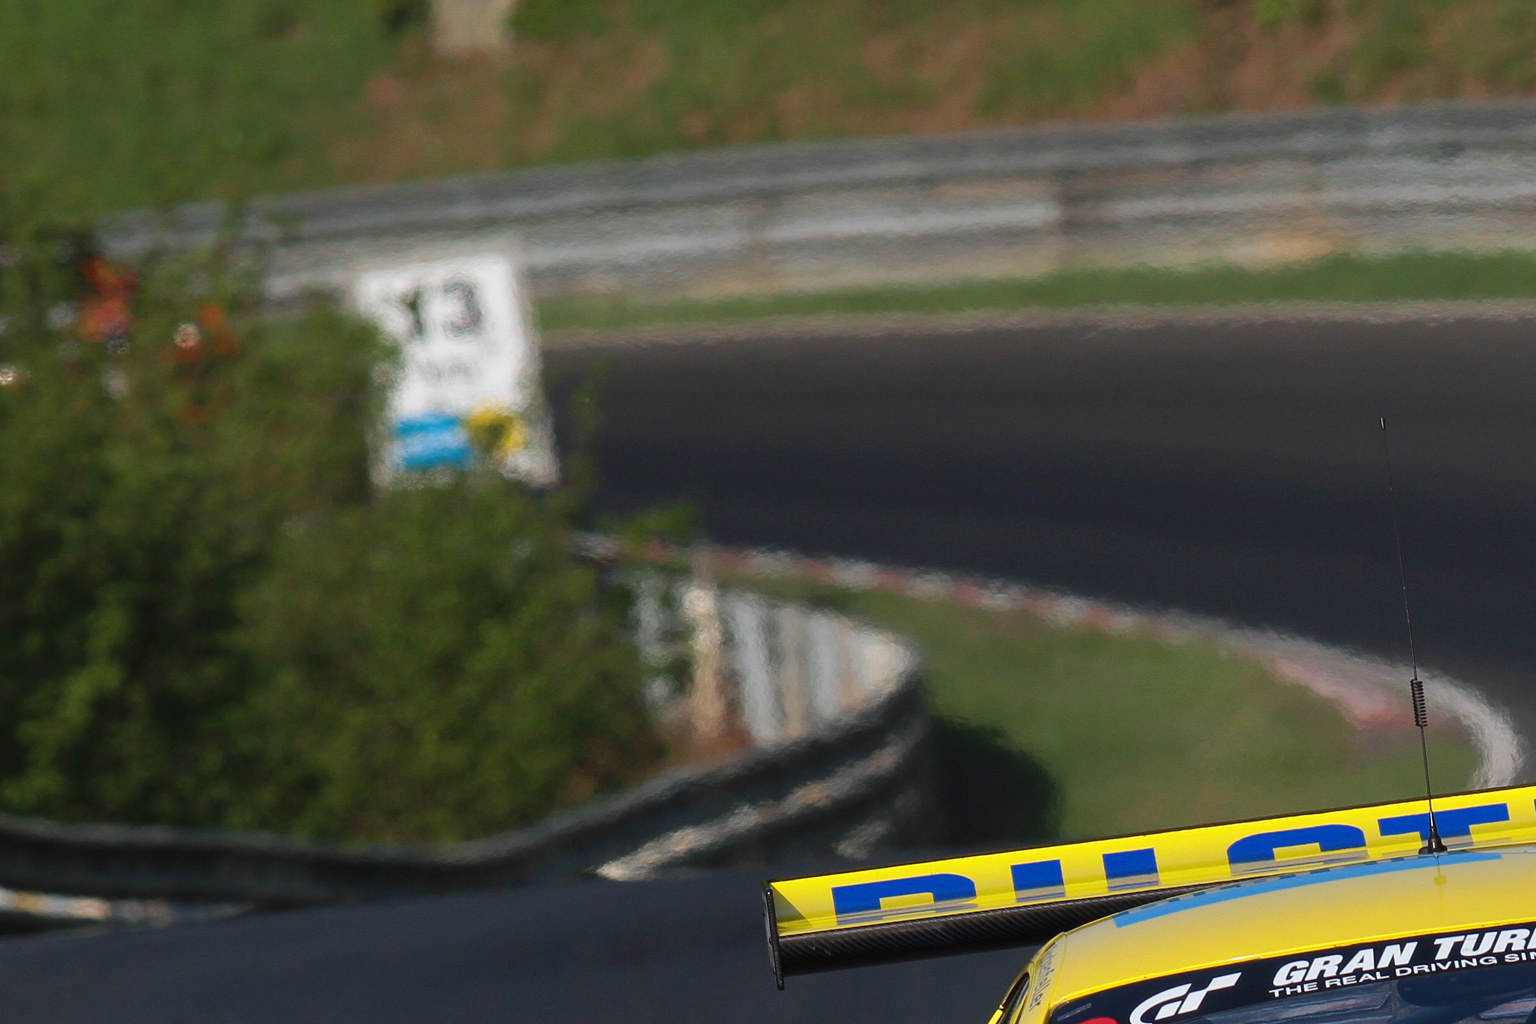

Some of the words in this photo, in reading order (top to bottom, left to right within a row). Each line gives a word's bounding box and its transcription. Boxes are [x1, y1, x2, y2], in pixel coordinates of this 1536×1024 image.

[1269, 983, 1327, 998] THE
[1331, 972, 1390, 989] REAL
[1394, 956, 1498, 978] DRIVING
[1272, 941, 1419, 987] GRAN
